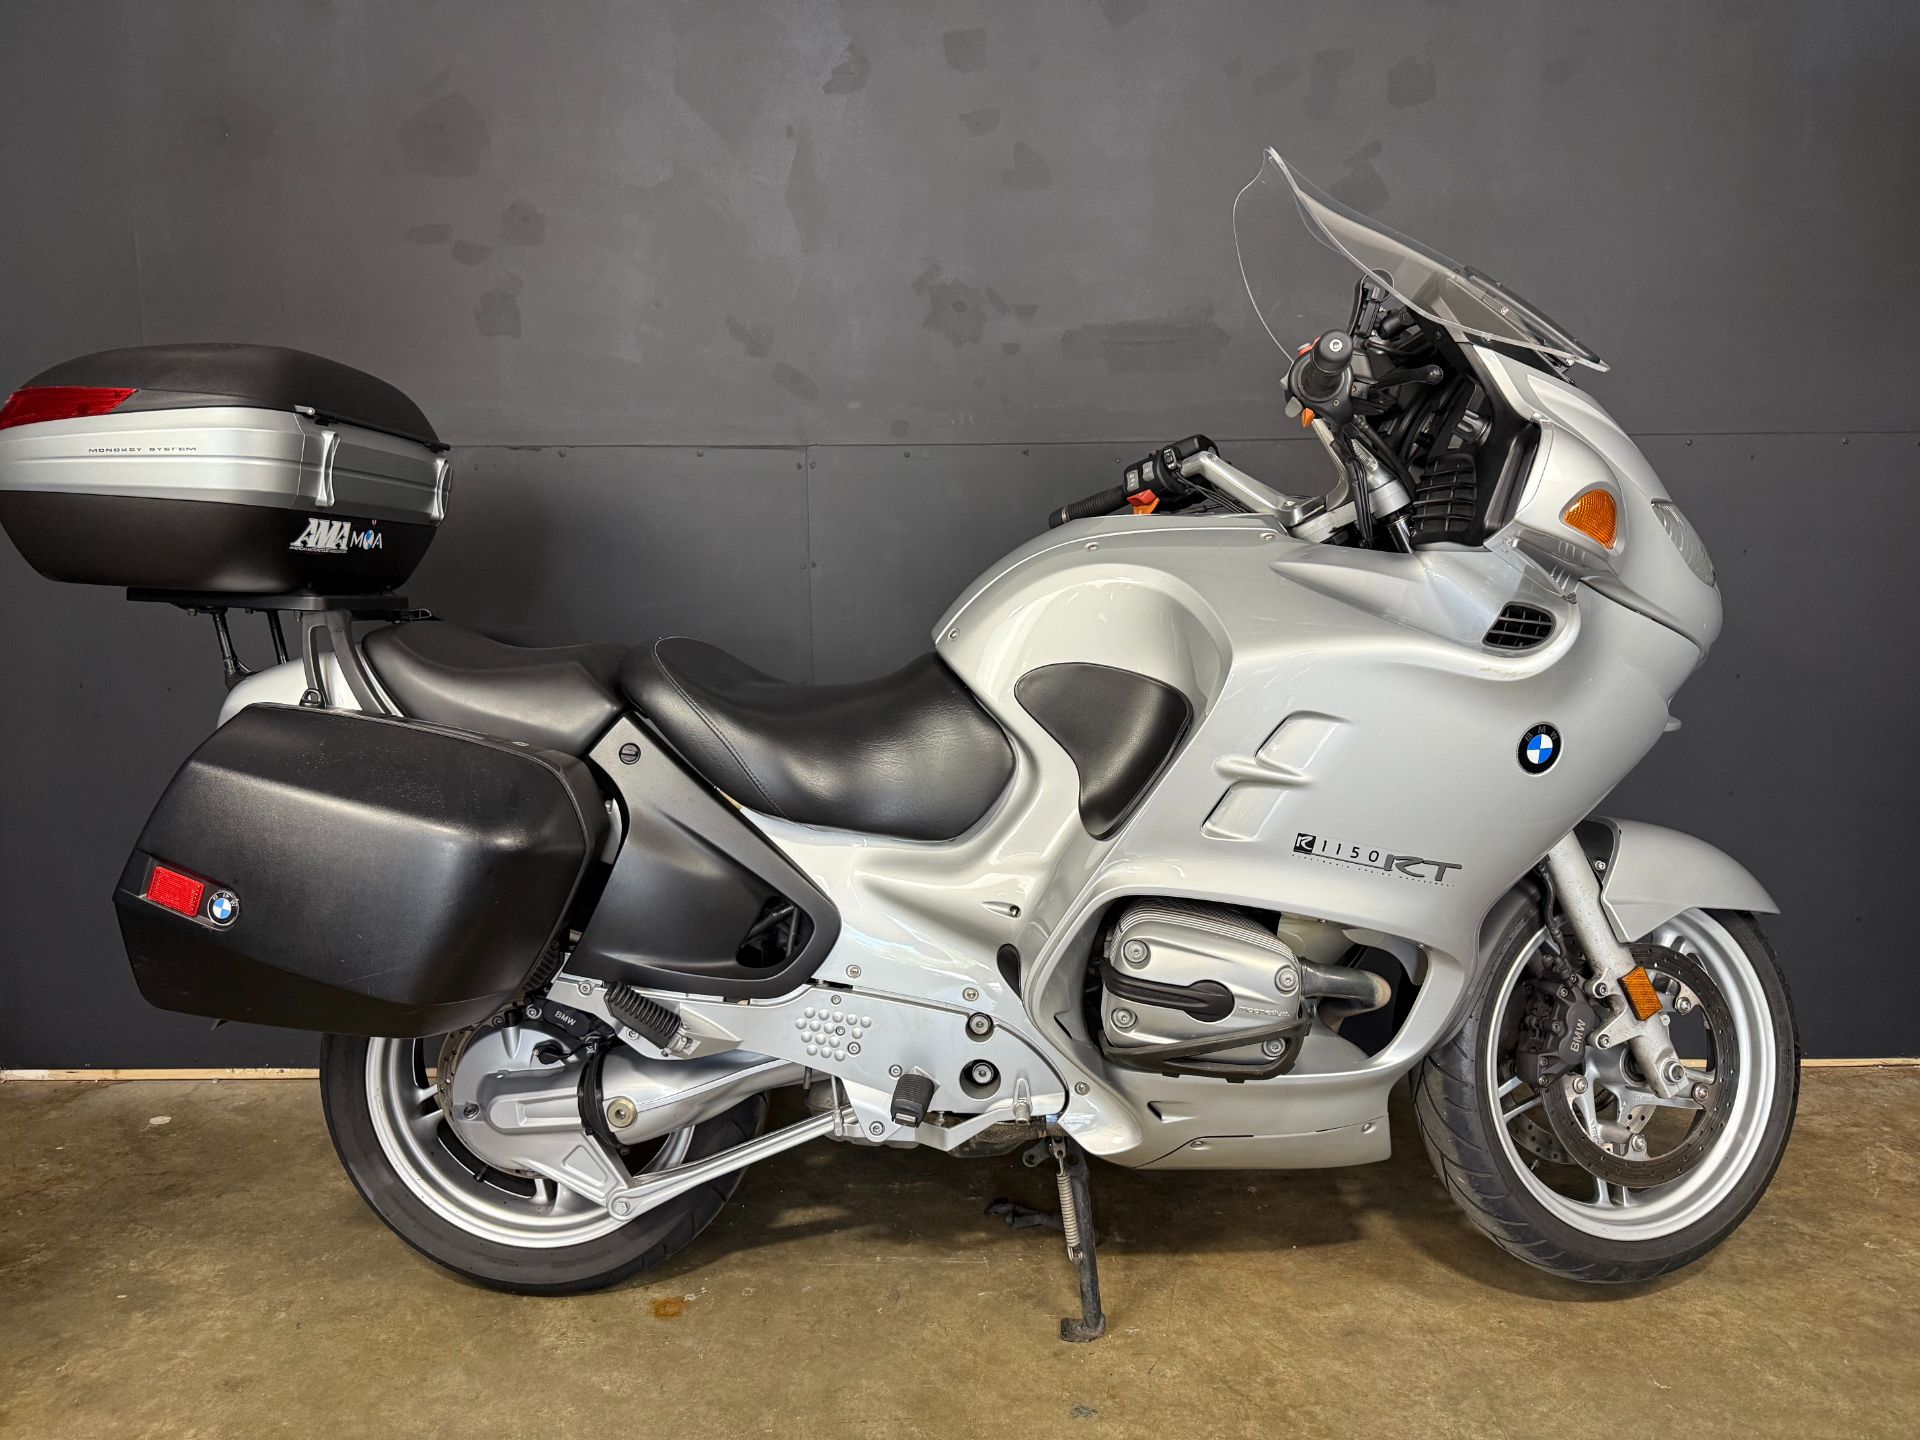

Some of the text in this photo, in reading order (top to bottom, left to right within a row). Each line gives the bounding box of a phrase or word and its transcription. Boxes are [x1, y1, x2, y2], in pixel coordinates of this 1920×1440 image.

[289, 517, 352, 551] AMA
[350, 529, 383, 550] MOA
[554, 1010, 577, 1026] BMW
[1570, 1018, 1587, 1053] BMW
